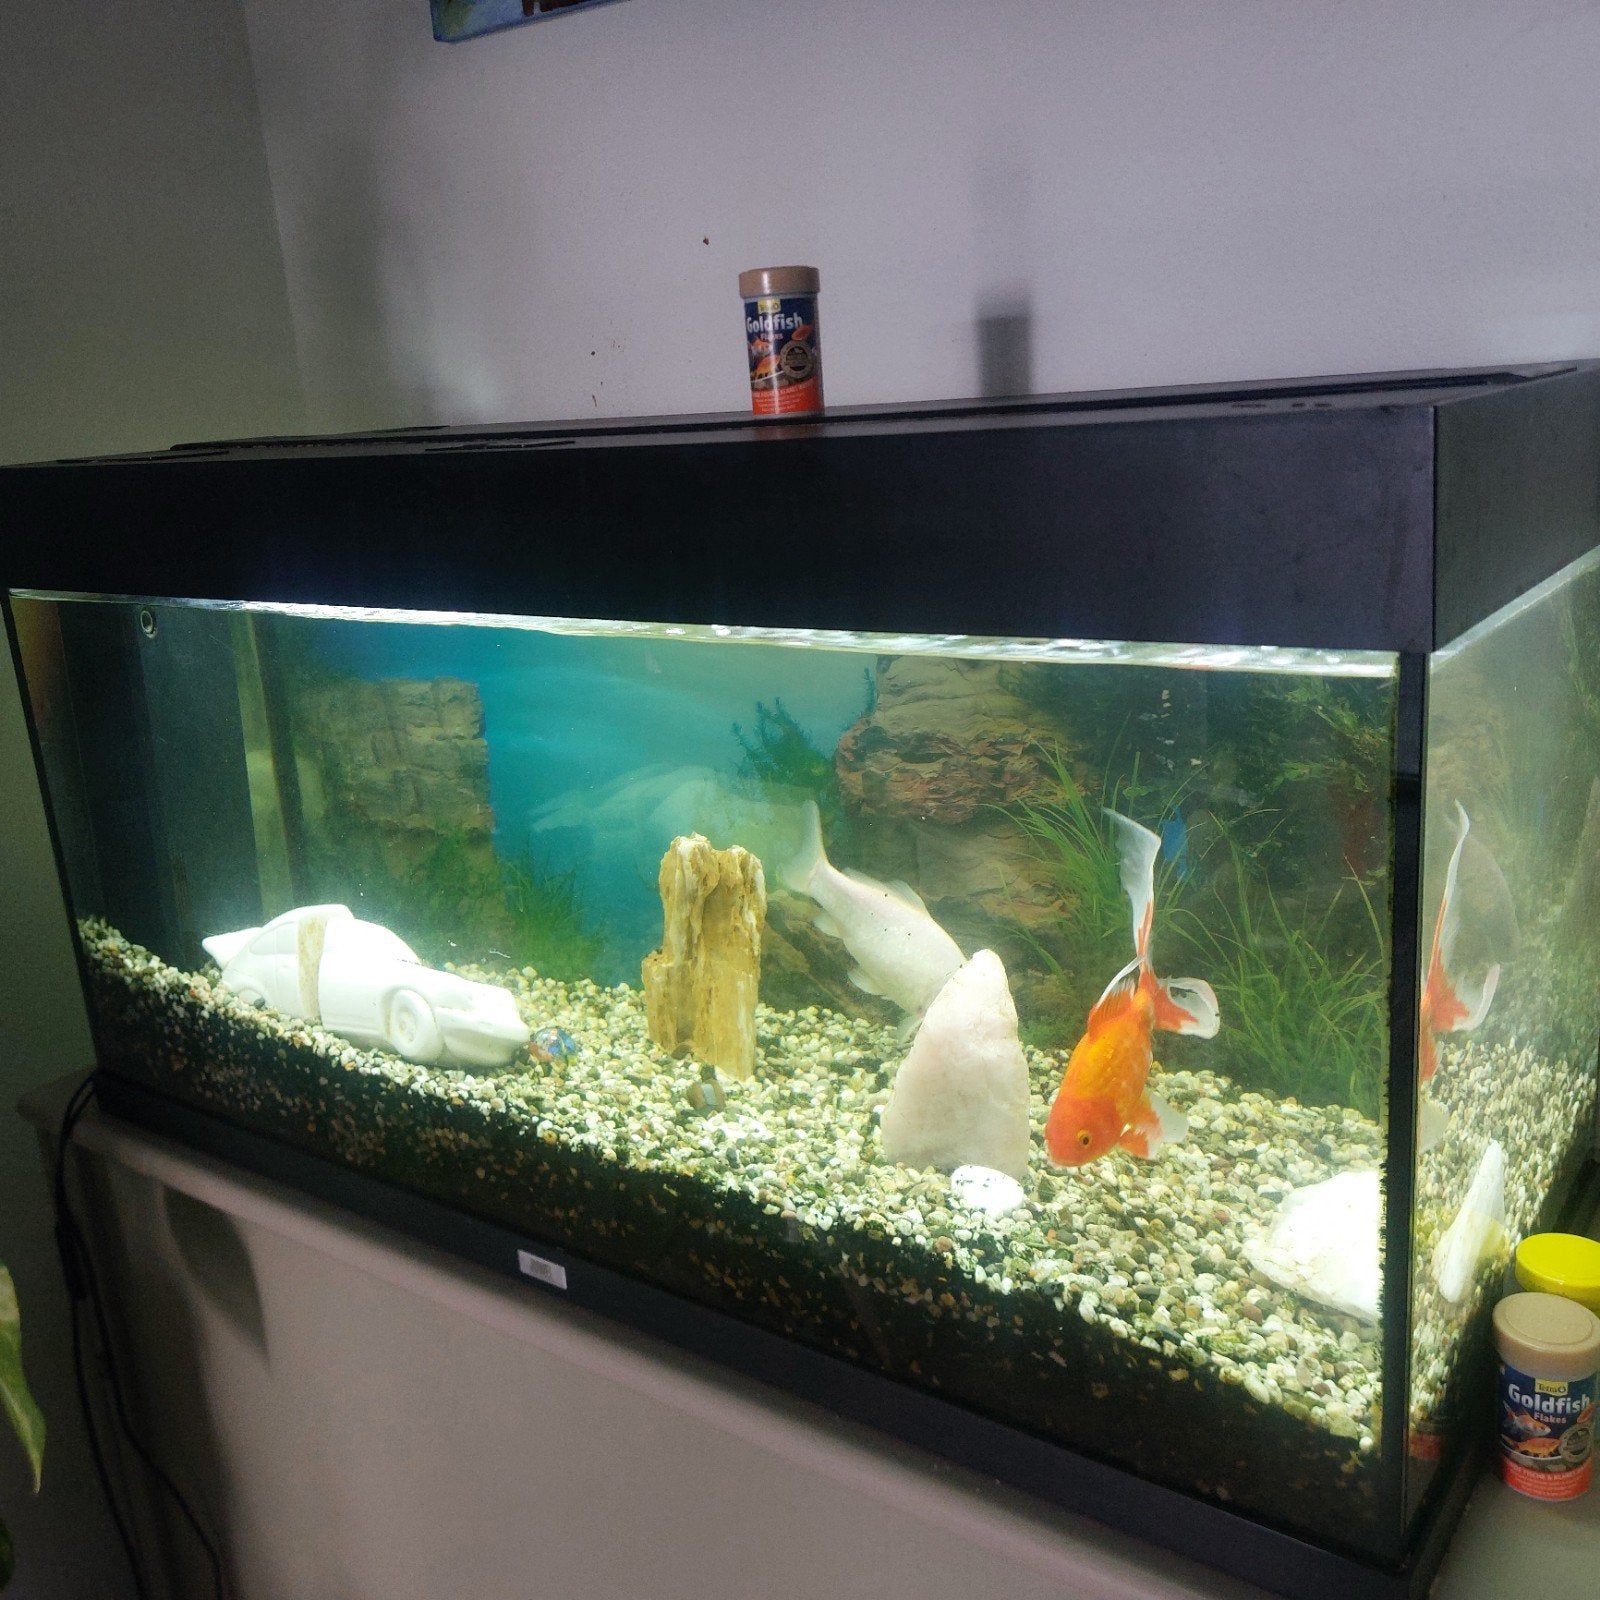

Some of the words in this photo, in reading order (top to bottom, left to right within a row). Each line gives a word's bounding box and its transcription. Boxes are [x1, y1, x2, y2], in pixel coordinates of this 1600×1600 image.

[746, 312, 803, 333] Goldfish
[1508, 1383, 1590, 1414] Goldfish
[1534, 1412, 1567, 1424] Flakes
